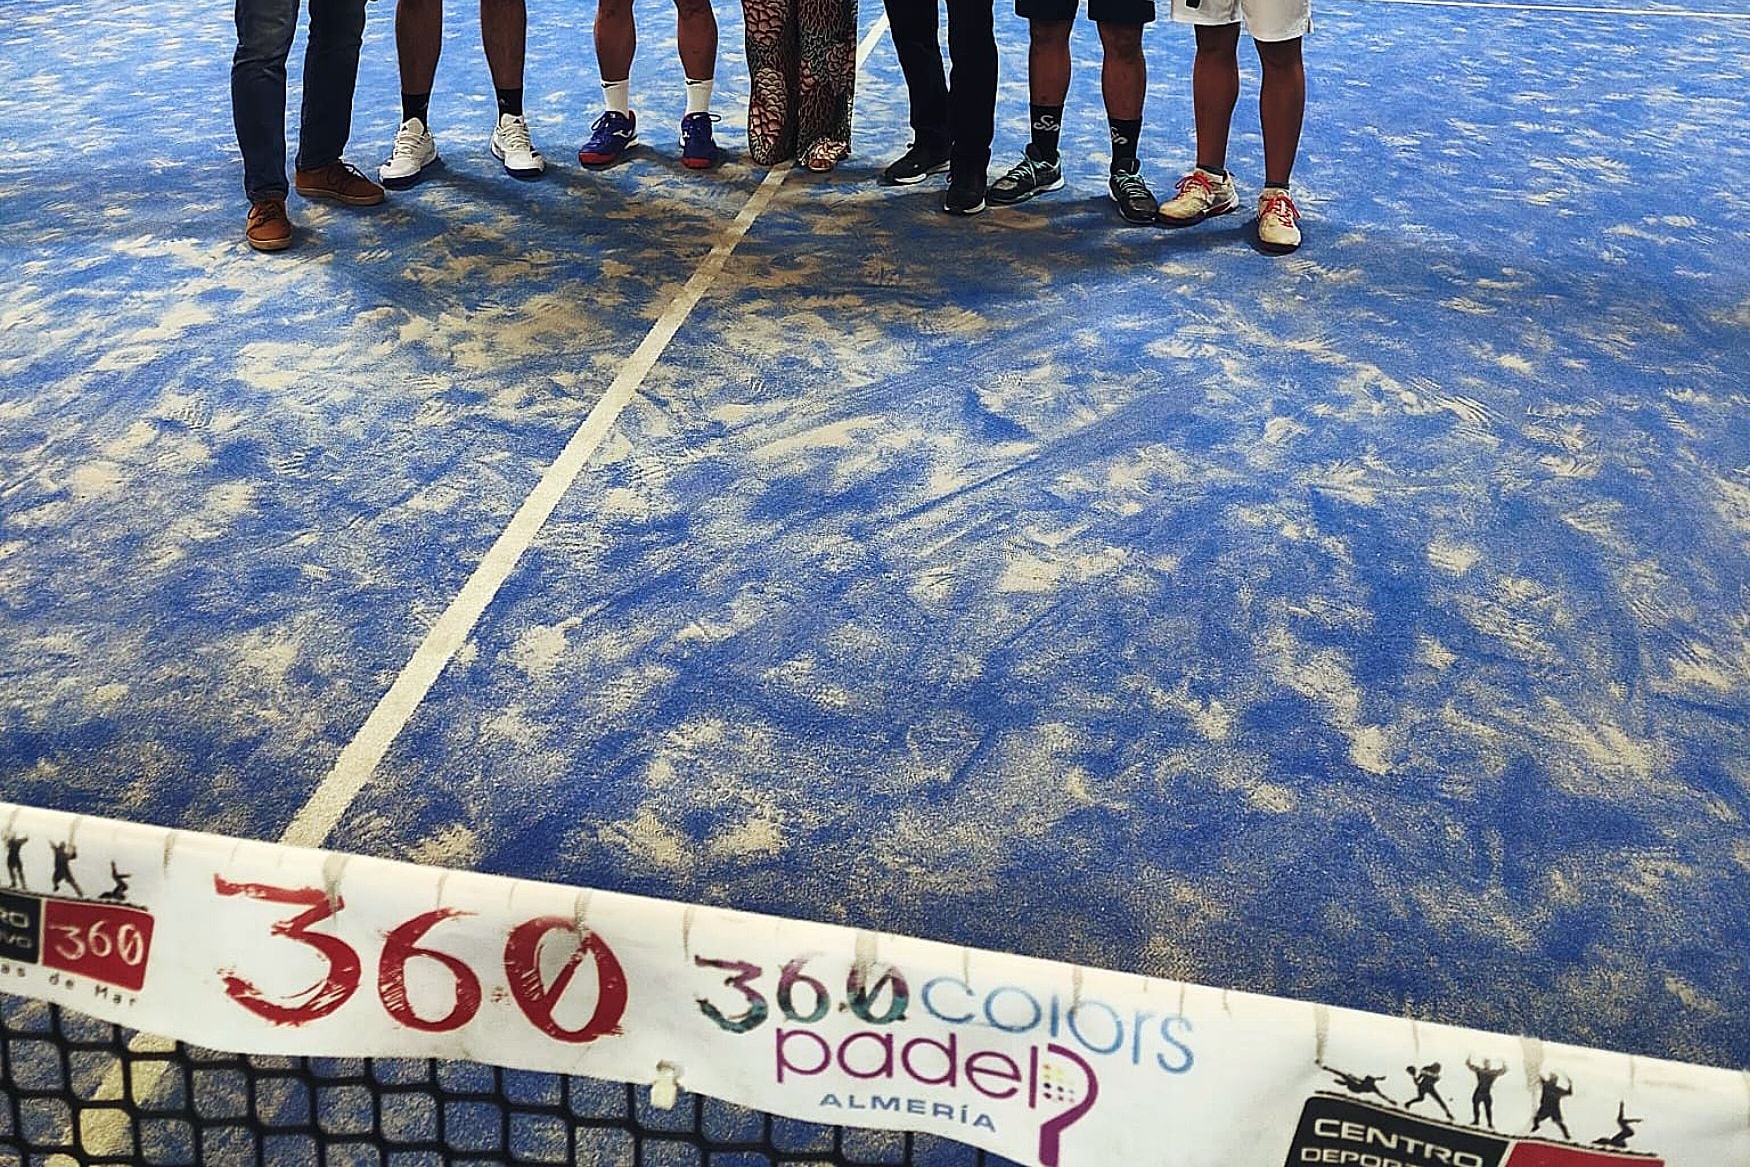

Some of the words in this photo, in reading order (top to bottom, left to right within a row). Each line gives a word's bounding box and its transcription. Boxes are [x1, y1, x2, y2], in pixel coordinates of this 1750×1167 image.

[50, 920, 144, 966] 360
[213, 872, 629, 1044] 360
[94, 985, 138, 1007] Mar
[775, 1026, 1040, 1110] padel
[819, 1092, 998, 1133] ALMERÍA
[1313, 1118, 1484, 1167] CENTRO
